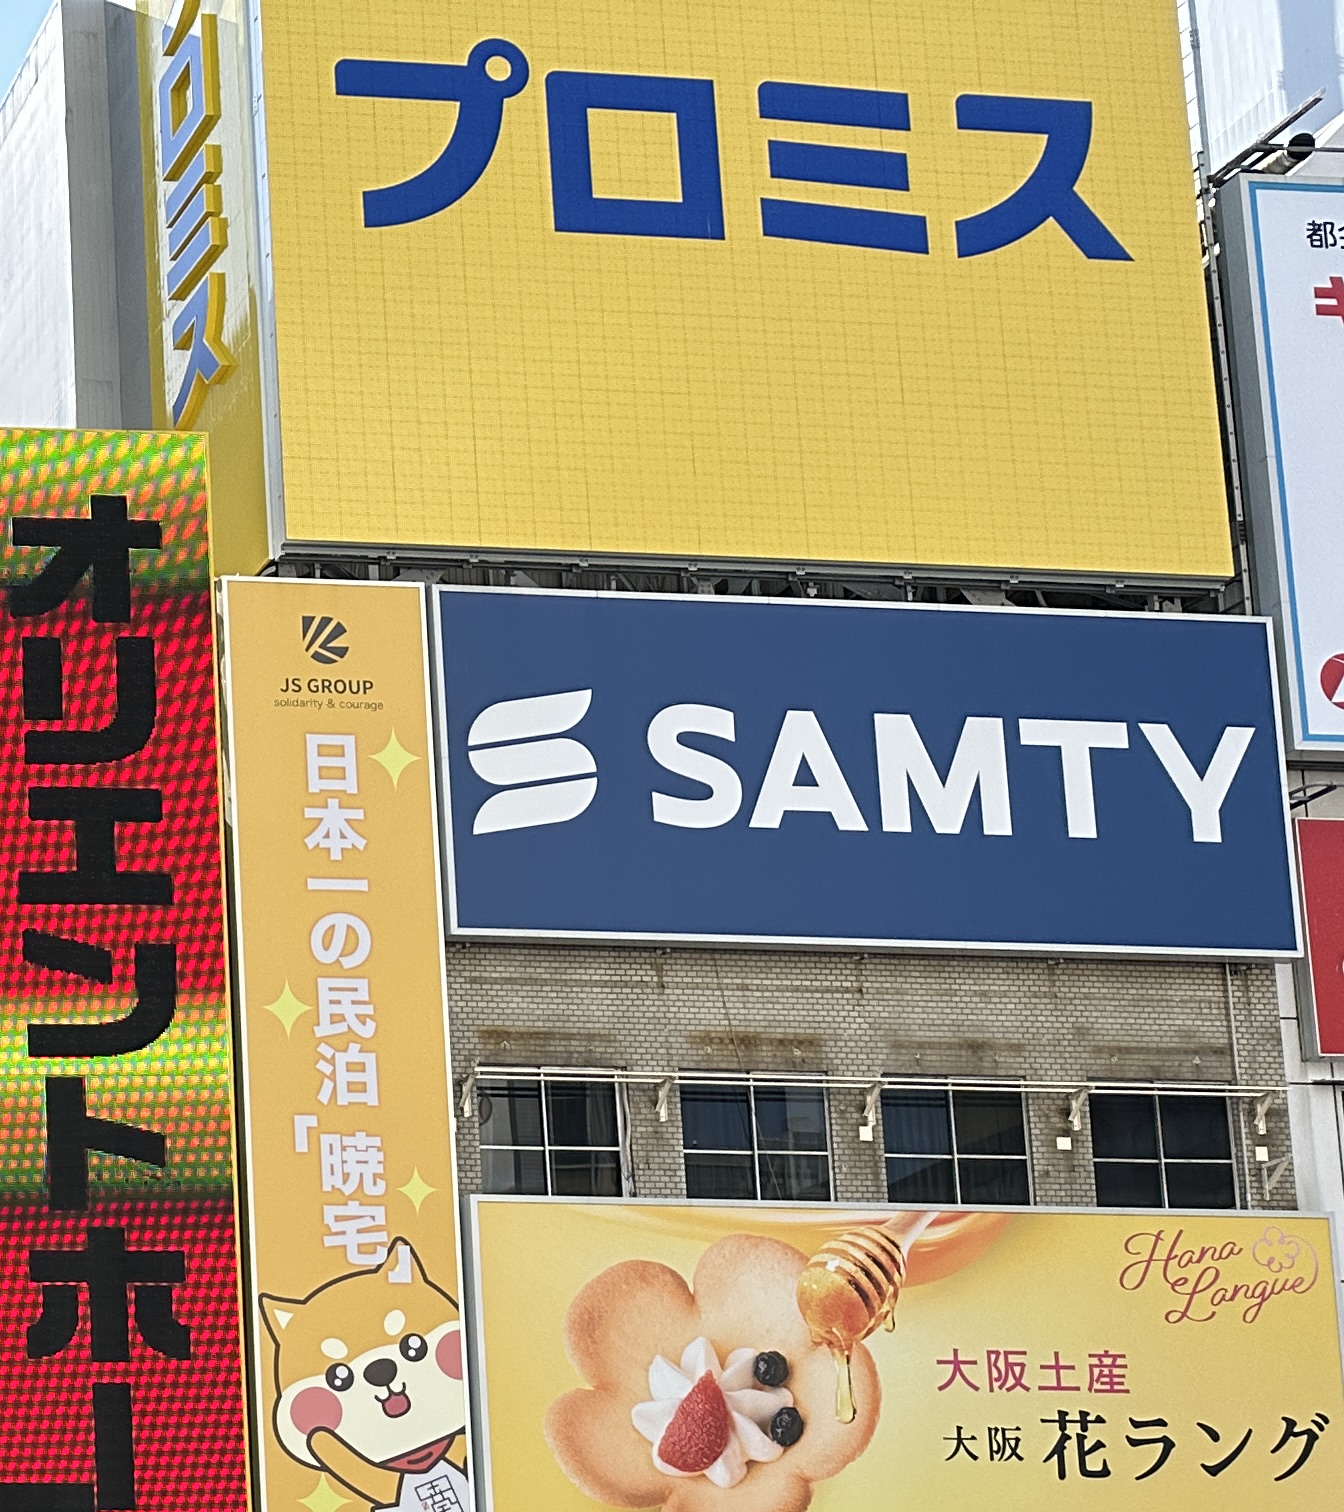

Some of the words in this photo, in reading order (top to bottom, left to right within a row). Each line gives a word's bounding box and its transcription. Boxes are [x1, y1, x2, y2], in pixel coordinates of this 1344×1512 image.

[335, 38, 1134, 262] プロミス
[161, 0, 232, 428] ロミス
[273, 698, 324, 711] solidarity
[339, 700, 384, 711] courage
[279, 677, 303, 693] JS
[307, 678, 374, 696] GROUP
[647, 703, 1255, 843] SAMTY
[1119, 1229, 1243, 1290] Hana
[1165, 1266, 1305, 1324] Langue
[936, 1349, 1131, 1395] 大阪土産
[943, 1426, 1024, 1464] 大阪
[1041, 1409, 1329, 1483] 花ラング
